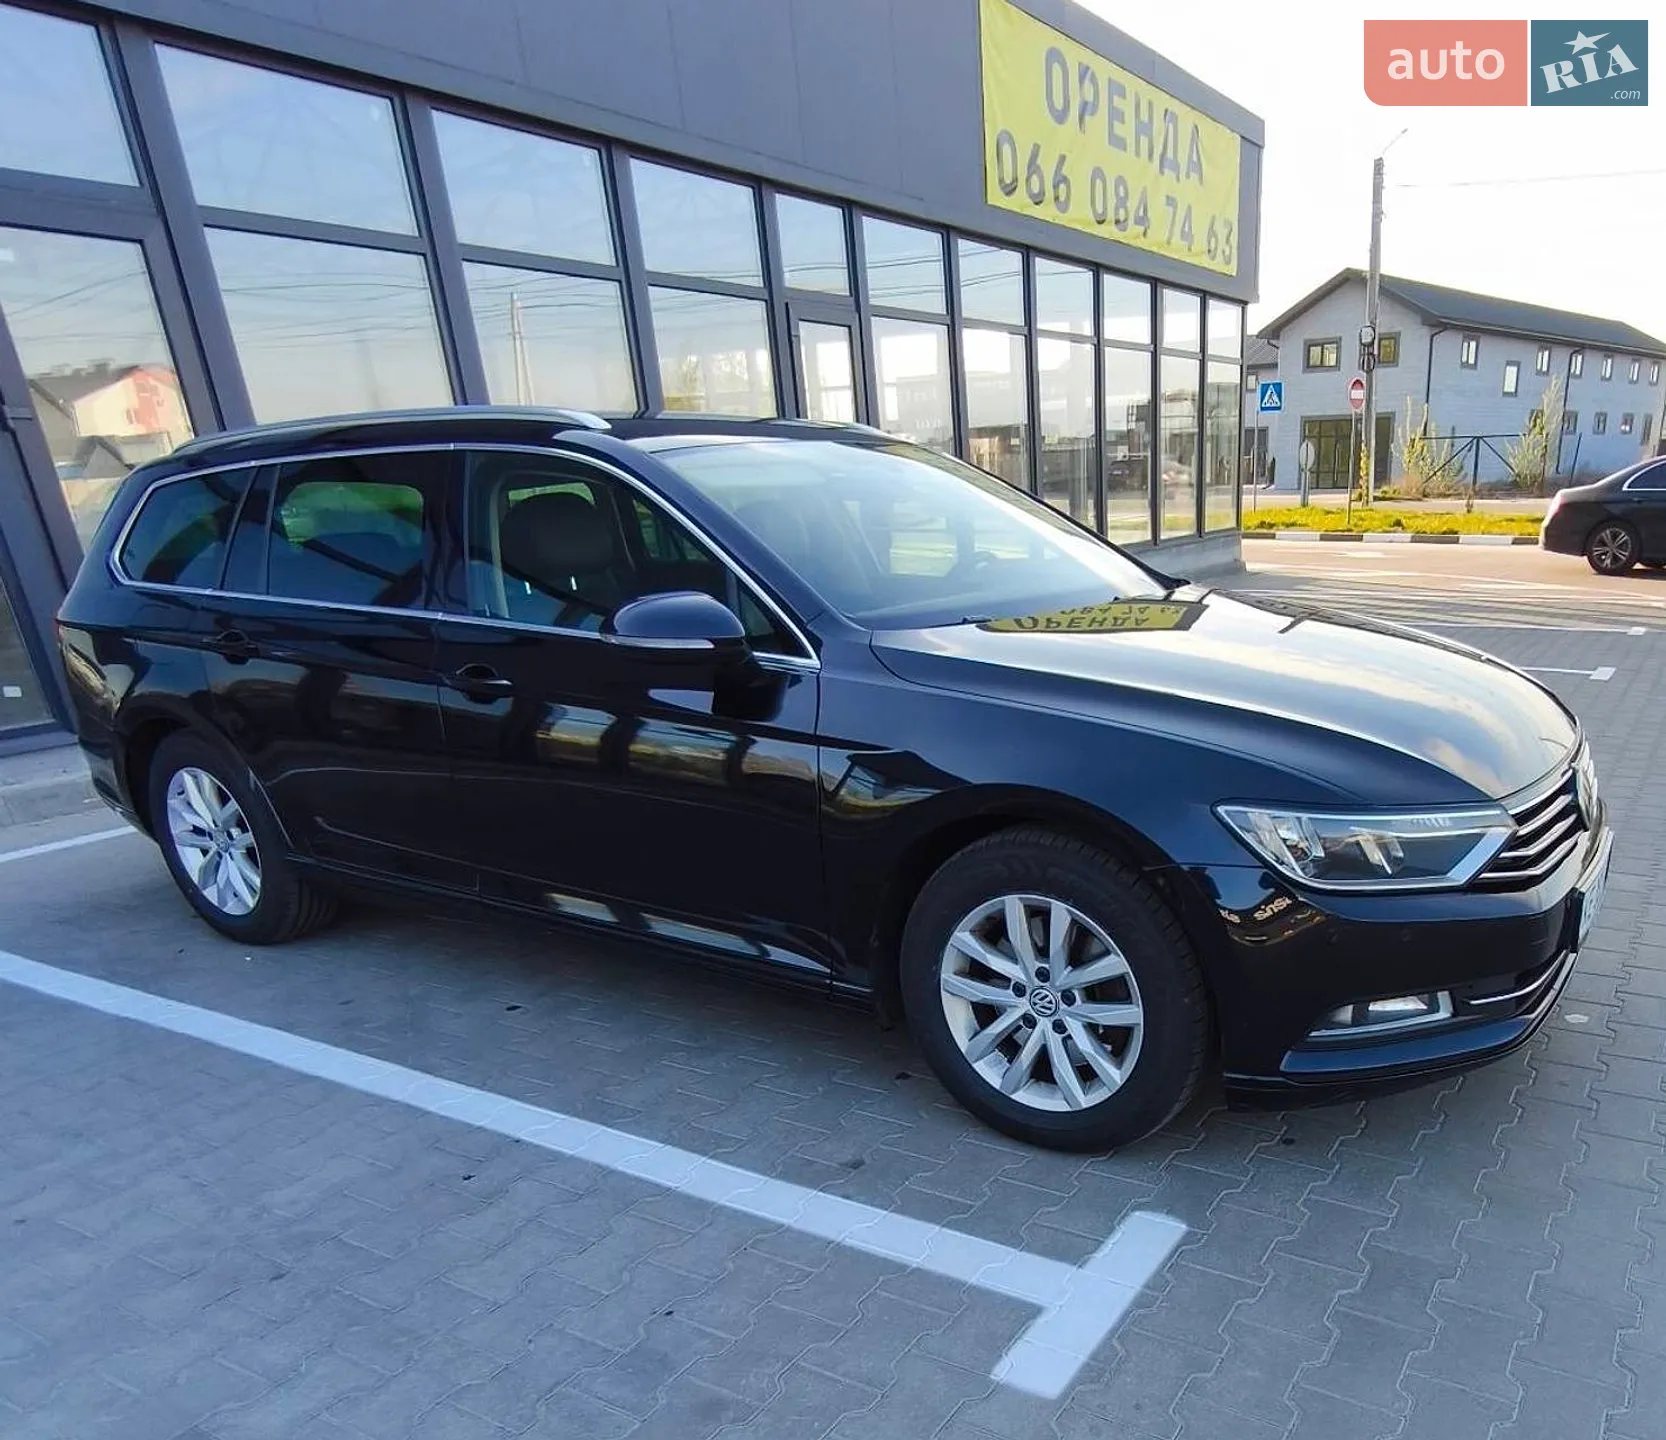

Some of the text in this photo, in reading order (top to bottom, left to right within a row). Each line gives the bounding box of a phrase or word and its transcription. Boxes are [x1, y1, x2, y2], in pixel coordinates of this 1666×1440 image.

[1044, 46, 1204, 186] ОРЕНДА
[995, 129, 1234, 266] 066 084 74 63
